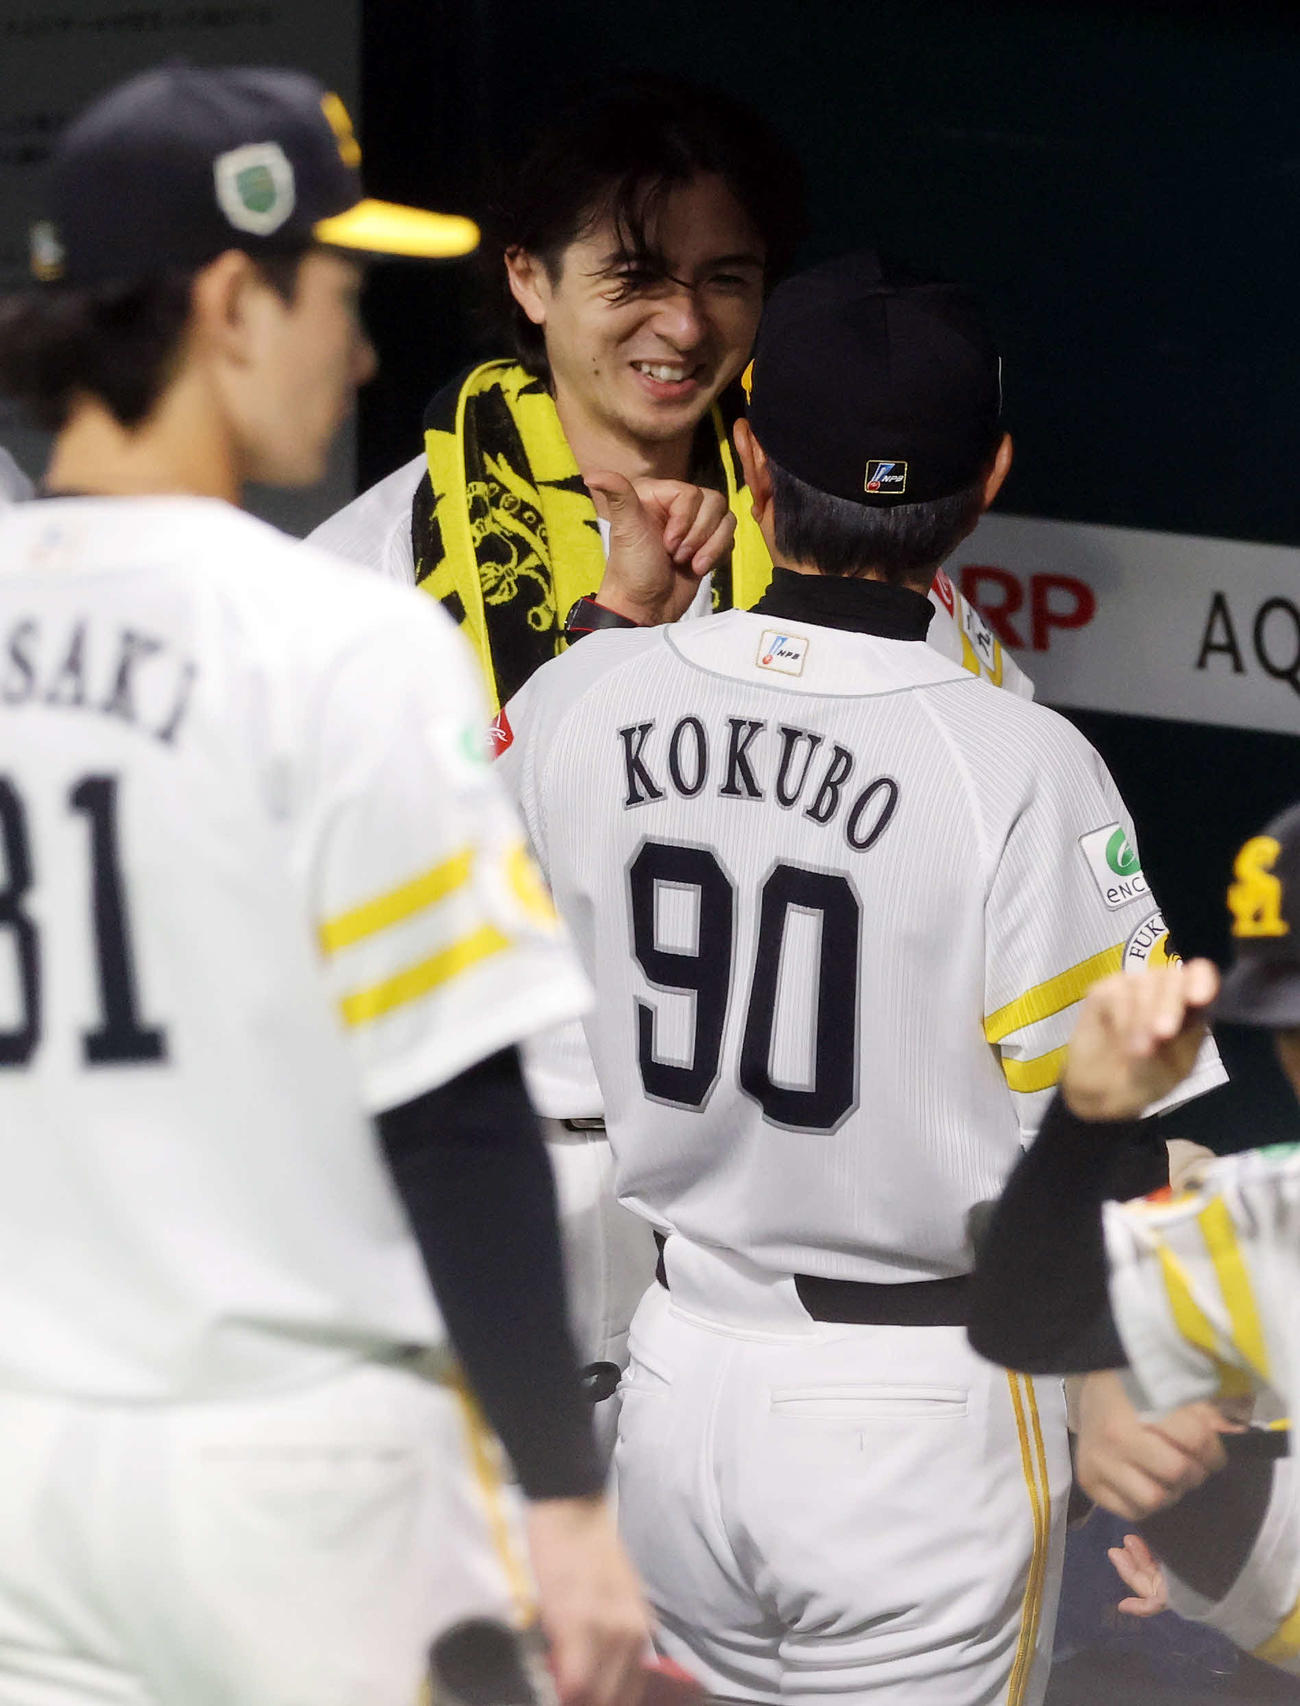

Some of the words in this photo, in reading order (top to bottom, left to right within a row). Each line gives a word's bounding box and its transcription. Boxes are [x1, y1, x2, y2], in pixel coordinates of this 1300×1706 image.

[881, 474, 904, 483] NPB
[777, 649, 800, 660] NPB
[960, 565, 1096, 652] RP
[1195, 590, 1300, 700] AQ
[3, 617, 199, 747] SAKI
[618, 715, 899, 853] KOKUBO
[625, 835, 863, 1136] 90
